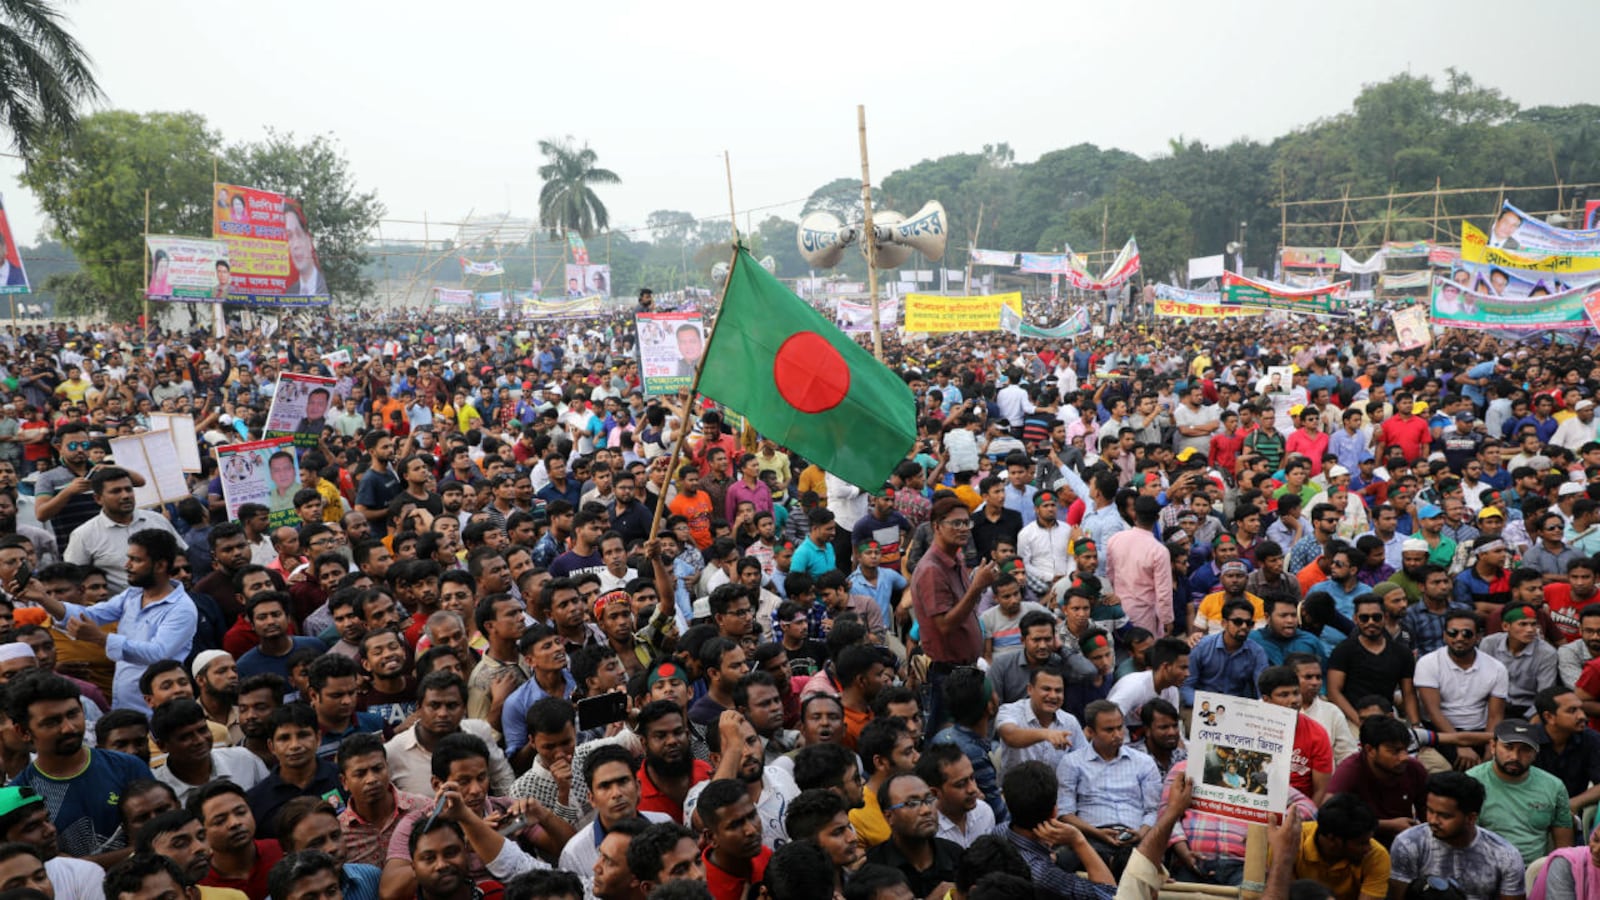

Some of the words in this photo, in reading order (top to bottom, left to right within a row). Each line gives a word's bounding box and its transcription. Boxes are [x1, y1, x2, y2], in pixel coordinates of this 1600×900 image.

[898, 211, 944, 237] তাহের
[1199, 729, 1222, 741] বেগম
[1224, 732, 1255, 748] খালেদা
[1257, 735, 1284, 753] জিয়ার
[1227, 793, 1249, 804] মুক্তি
[1253, 799, 1270, 808] চাই
